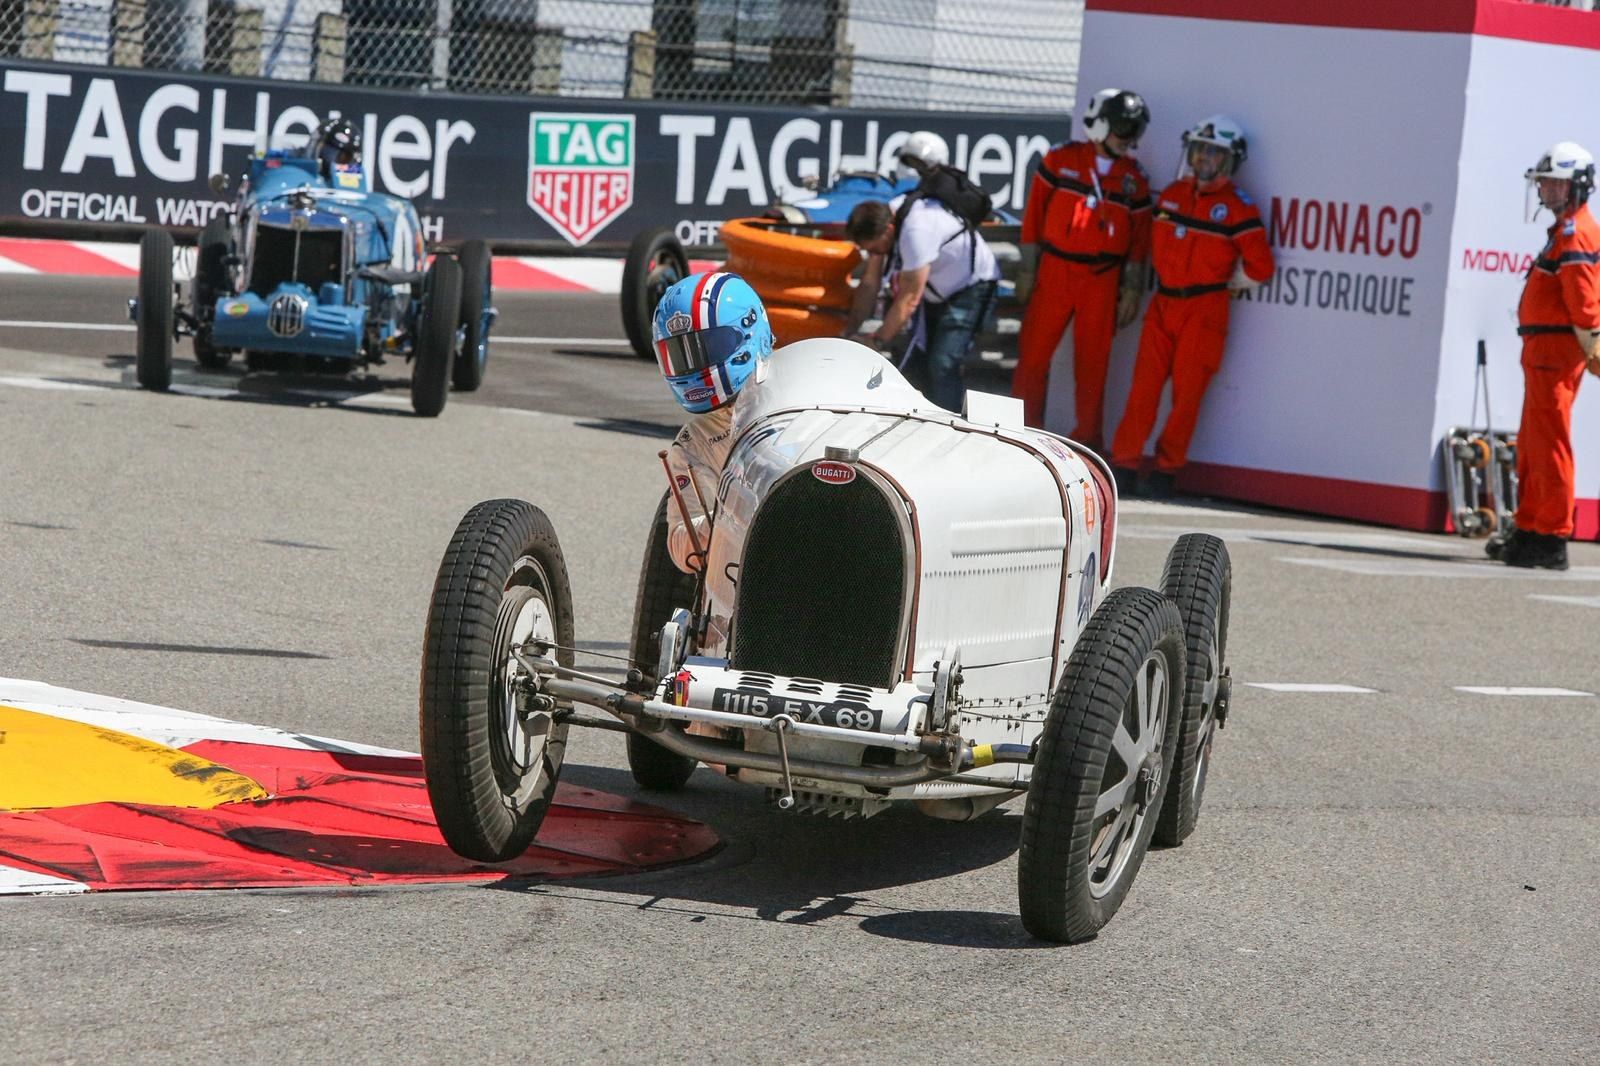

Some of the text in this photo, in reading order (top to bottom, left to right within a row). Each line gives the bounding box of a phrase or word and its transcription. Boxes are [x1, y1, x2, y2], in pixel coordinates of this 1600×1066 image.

[538, 122, 626, 164] TAG
[21, 189, 146, 223] OFFICIAL
[534, 173, 627, 235] HEUER
[1257, 266, 1414, 317] HISTORIQUE
[816, 467, 851, 479] BUGATTI
[722, 692, 769, 716] 1115
[835, 707, 874, 731] 69
